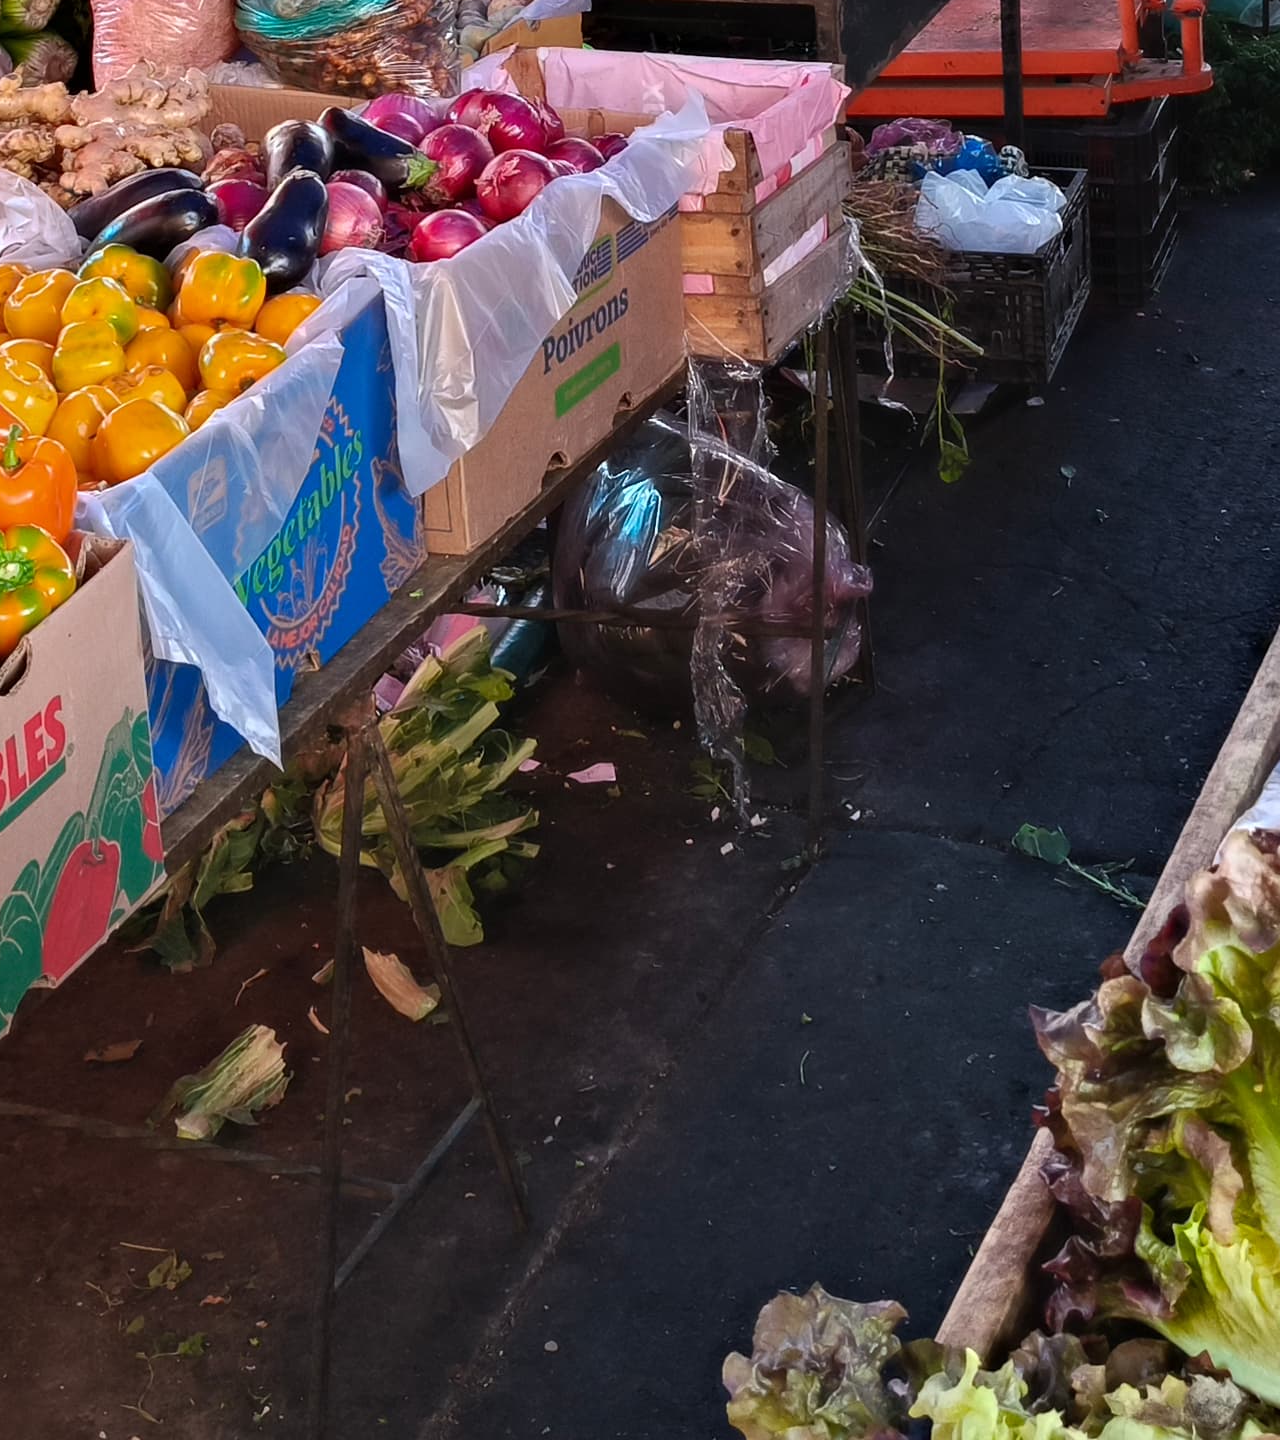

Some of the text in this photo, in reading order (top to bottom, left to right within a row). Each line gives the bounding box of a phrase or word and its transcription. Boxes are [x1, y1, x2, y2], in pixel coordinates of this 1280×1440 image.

[541, 287, 629, 375] Poivrons
[233, 428, 364, 609] Vegetables
[279, 616, 320, 650] MEJOR
[318, 523, 353, 621] CALIDAD
